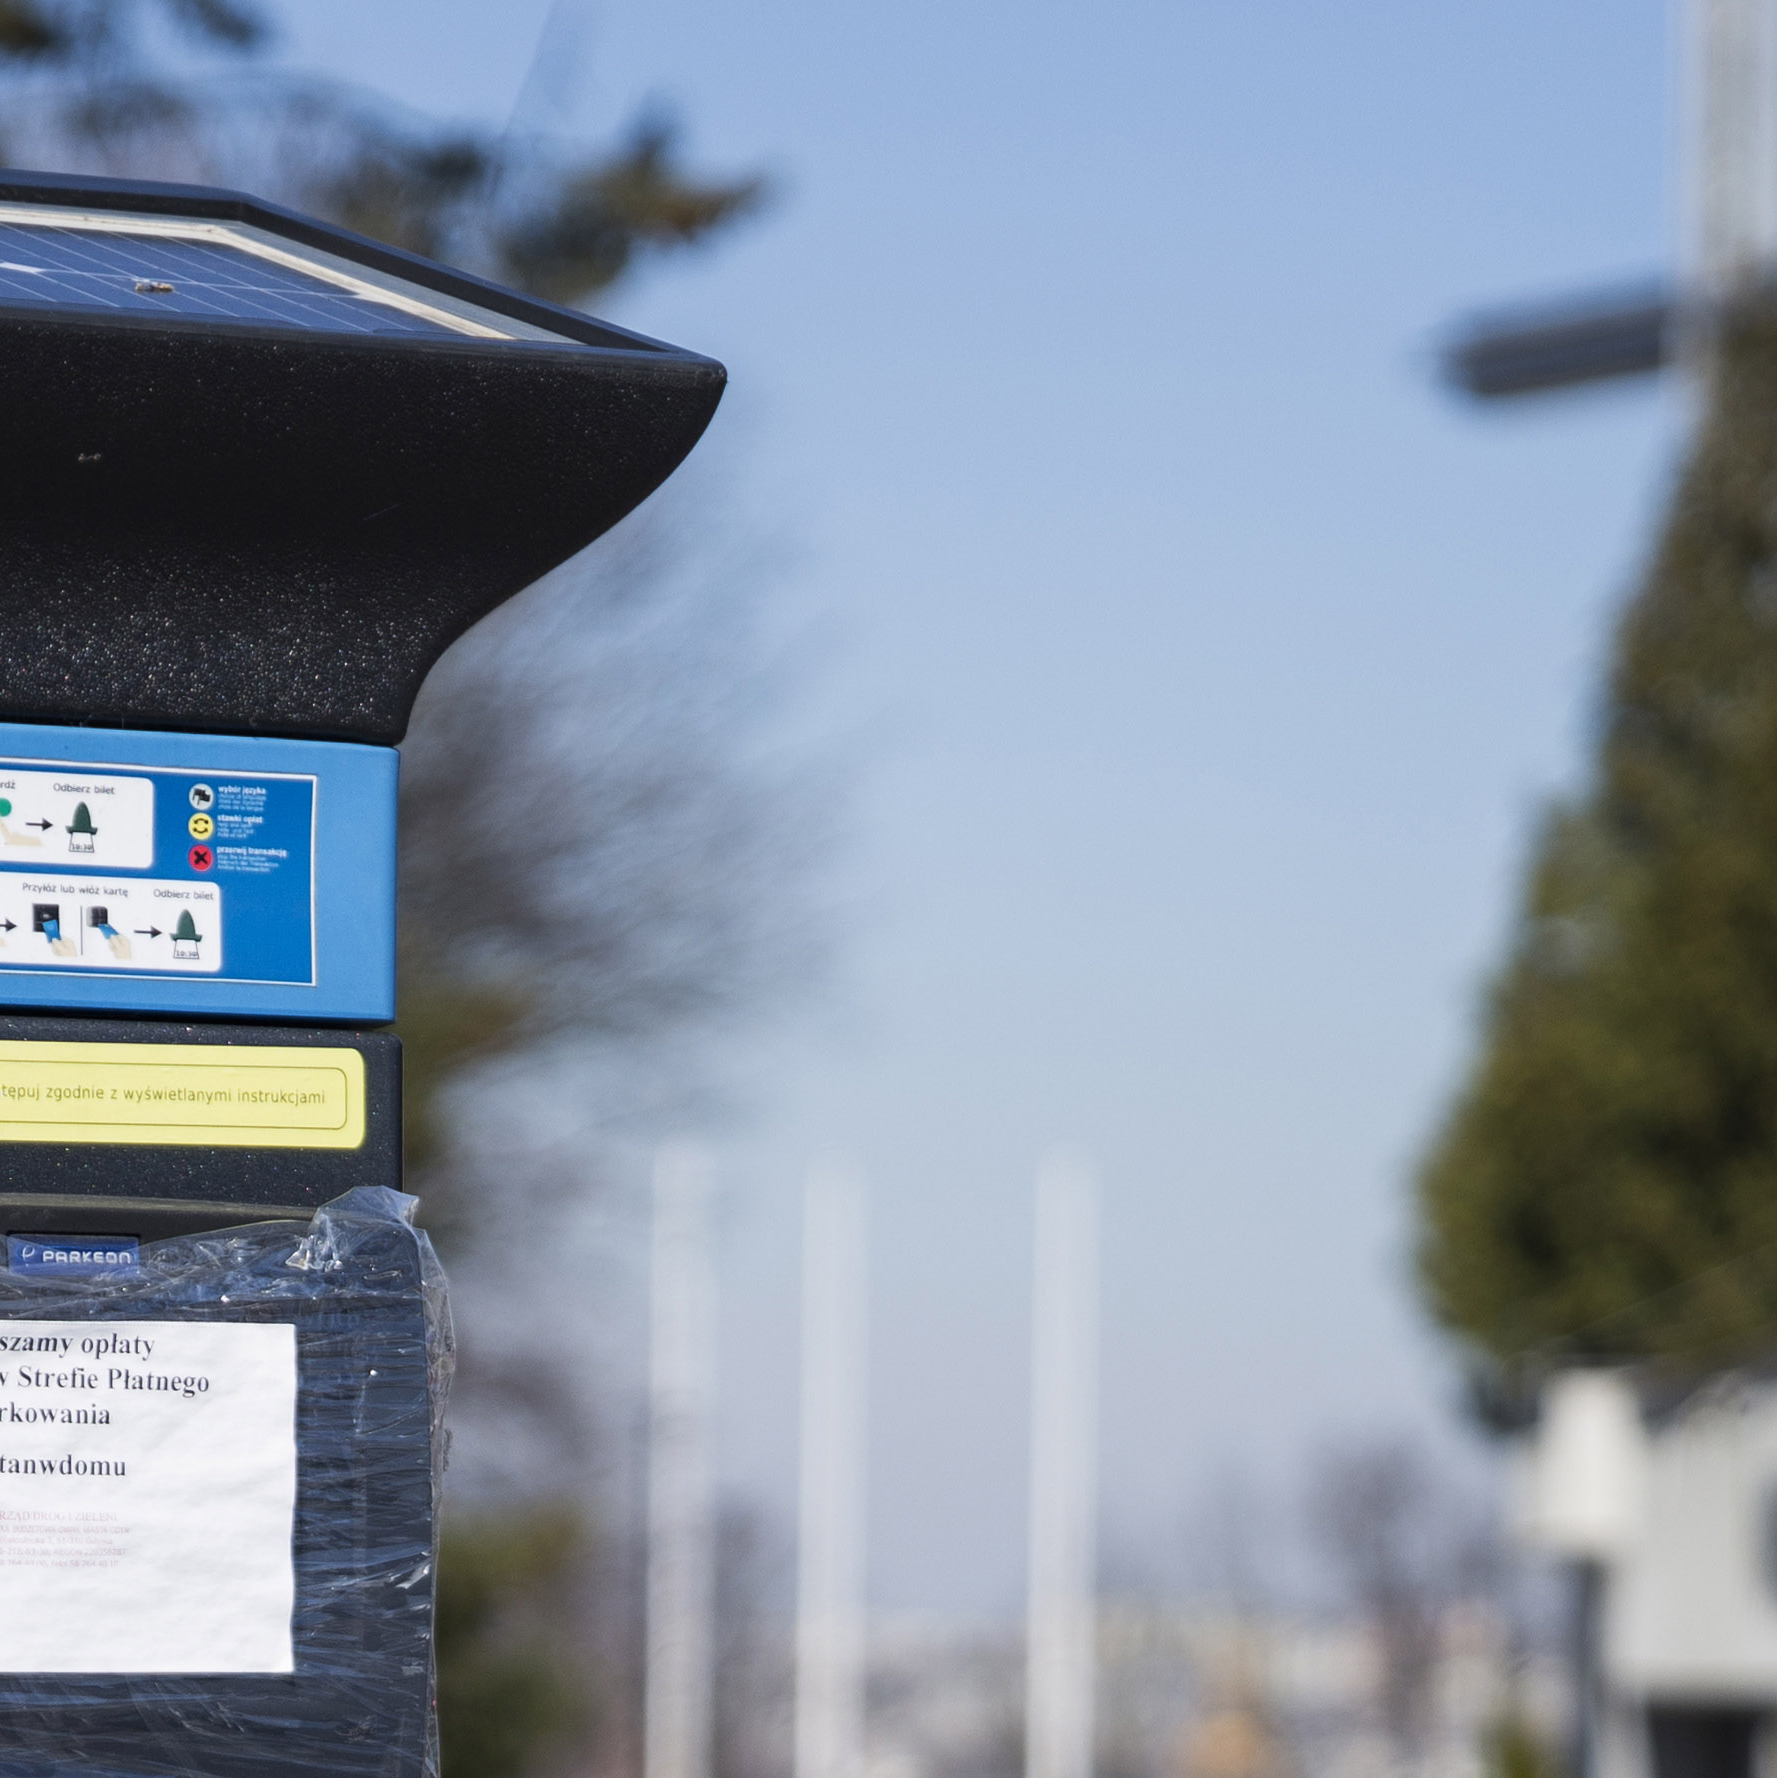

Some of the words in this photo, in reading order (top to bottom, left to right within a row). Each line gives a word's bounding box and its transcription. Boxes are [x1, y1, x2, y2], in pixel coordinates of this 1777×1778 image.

[53, 783, 91, 794] Odbierz
[94, 784, 116, 795] bilet
[60, 884, 75, 895] lub
[103, 886, 128, 898] kartę
[154, 888, 190, 900] Odbierz
[194, 890, 215, 901] bilet
[46, 1086, 104, 1102] zgodnie
[110, 1088, 118, 1100] z
[123, 1086, 232, 1105] wyświetlanymi
[237, 1088, 326, 1107] instrukcjami
[43, 1250, 132, 1265] PARKEON
[80, 1333, 156, 1361] opłaty
[18, 1366, 99, 1390] Strefie
[108, 1368, 211, 1399] Płatnego
